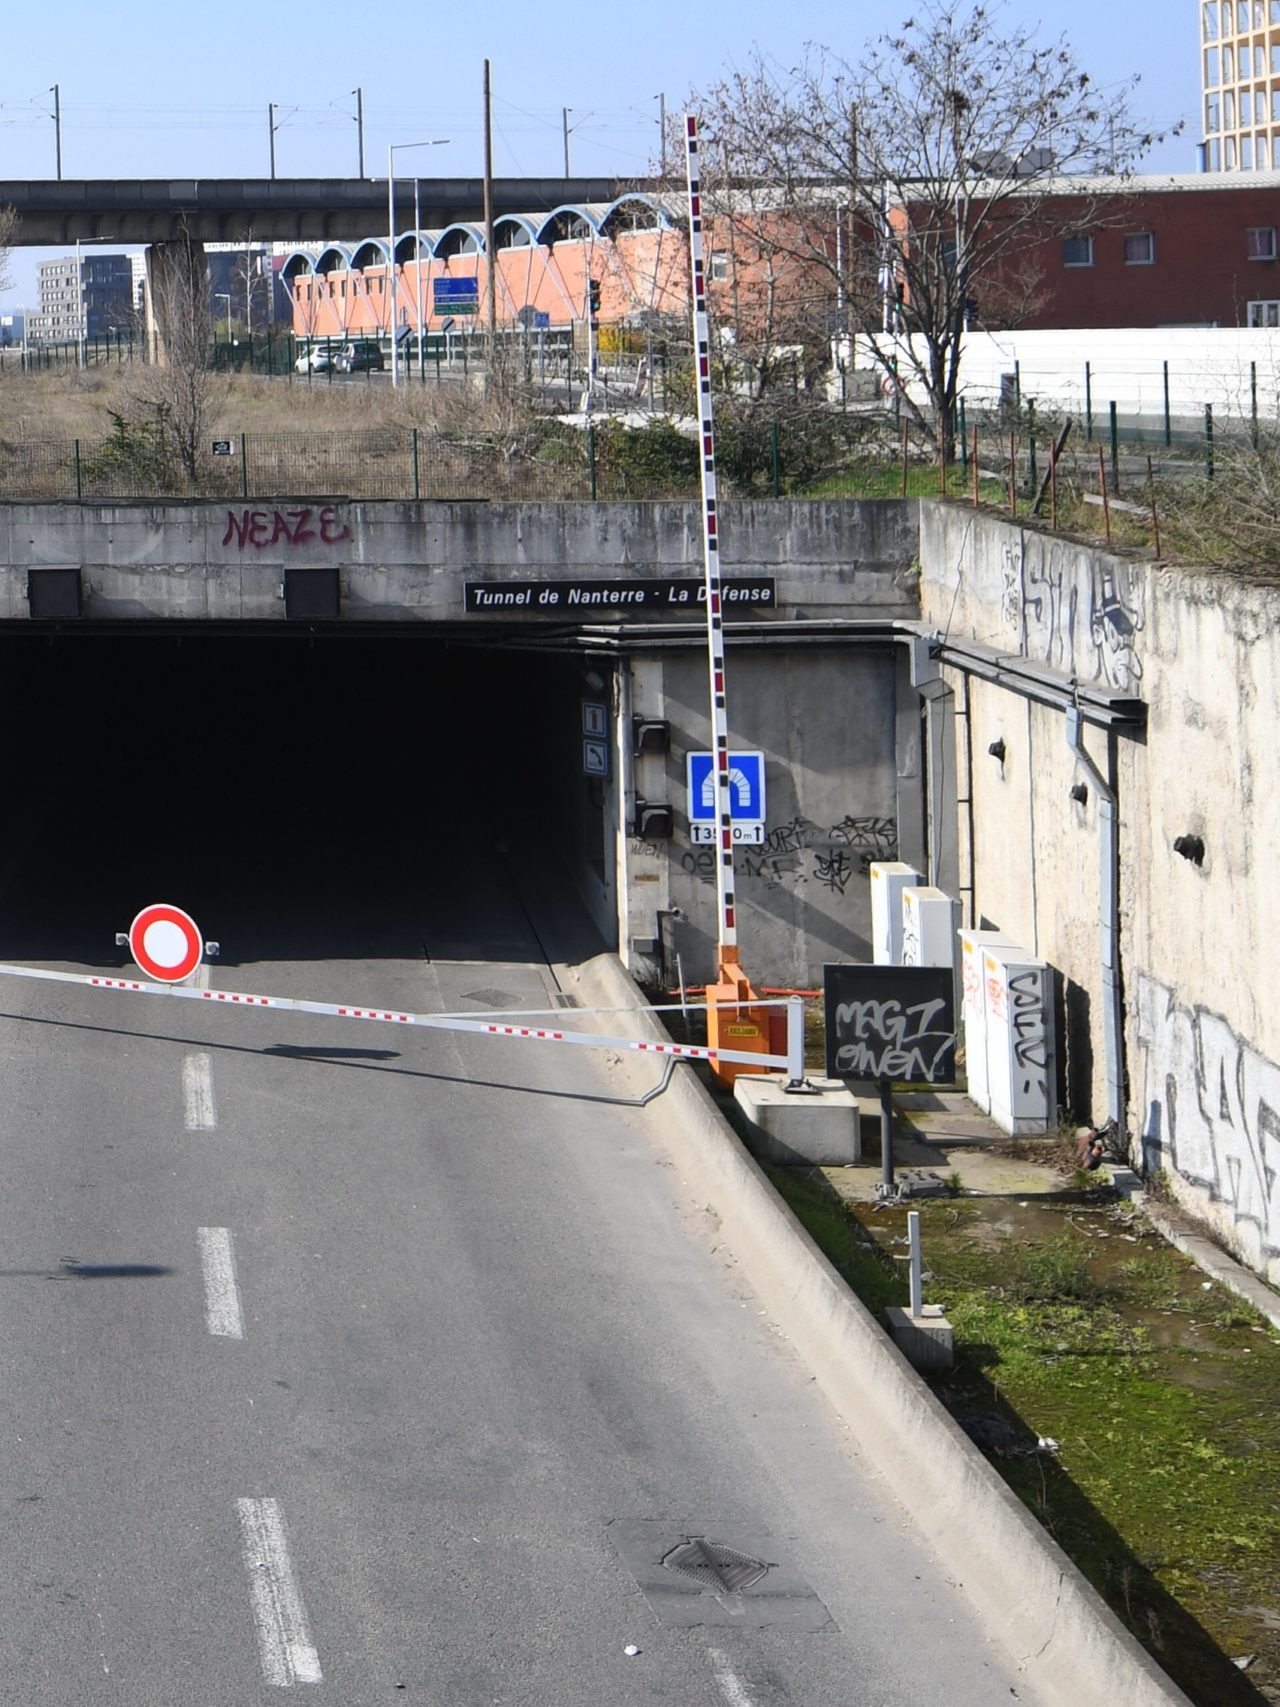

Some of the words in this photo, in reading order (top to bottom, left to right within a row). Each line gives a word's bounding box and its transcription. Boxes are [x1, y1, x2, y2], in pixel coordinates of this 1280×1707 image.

[223, 507, 352, 550] NEAZE
[473, 589, 531, 605] Tunnel
[538, 588, 560, 604] de
[567, 587, 645, 605] Nanterre
[668, 586, 688, 602] La
[696, 585, 771, 602] Dfense
